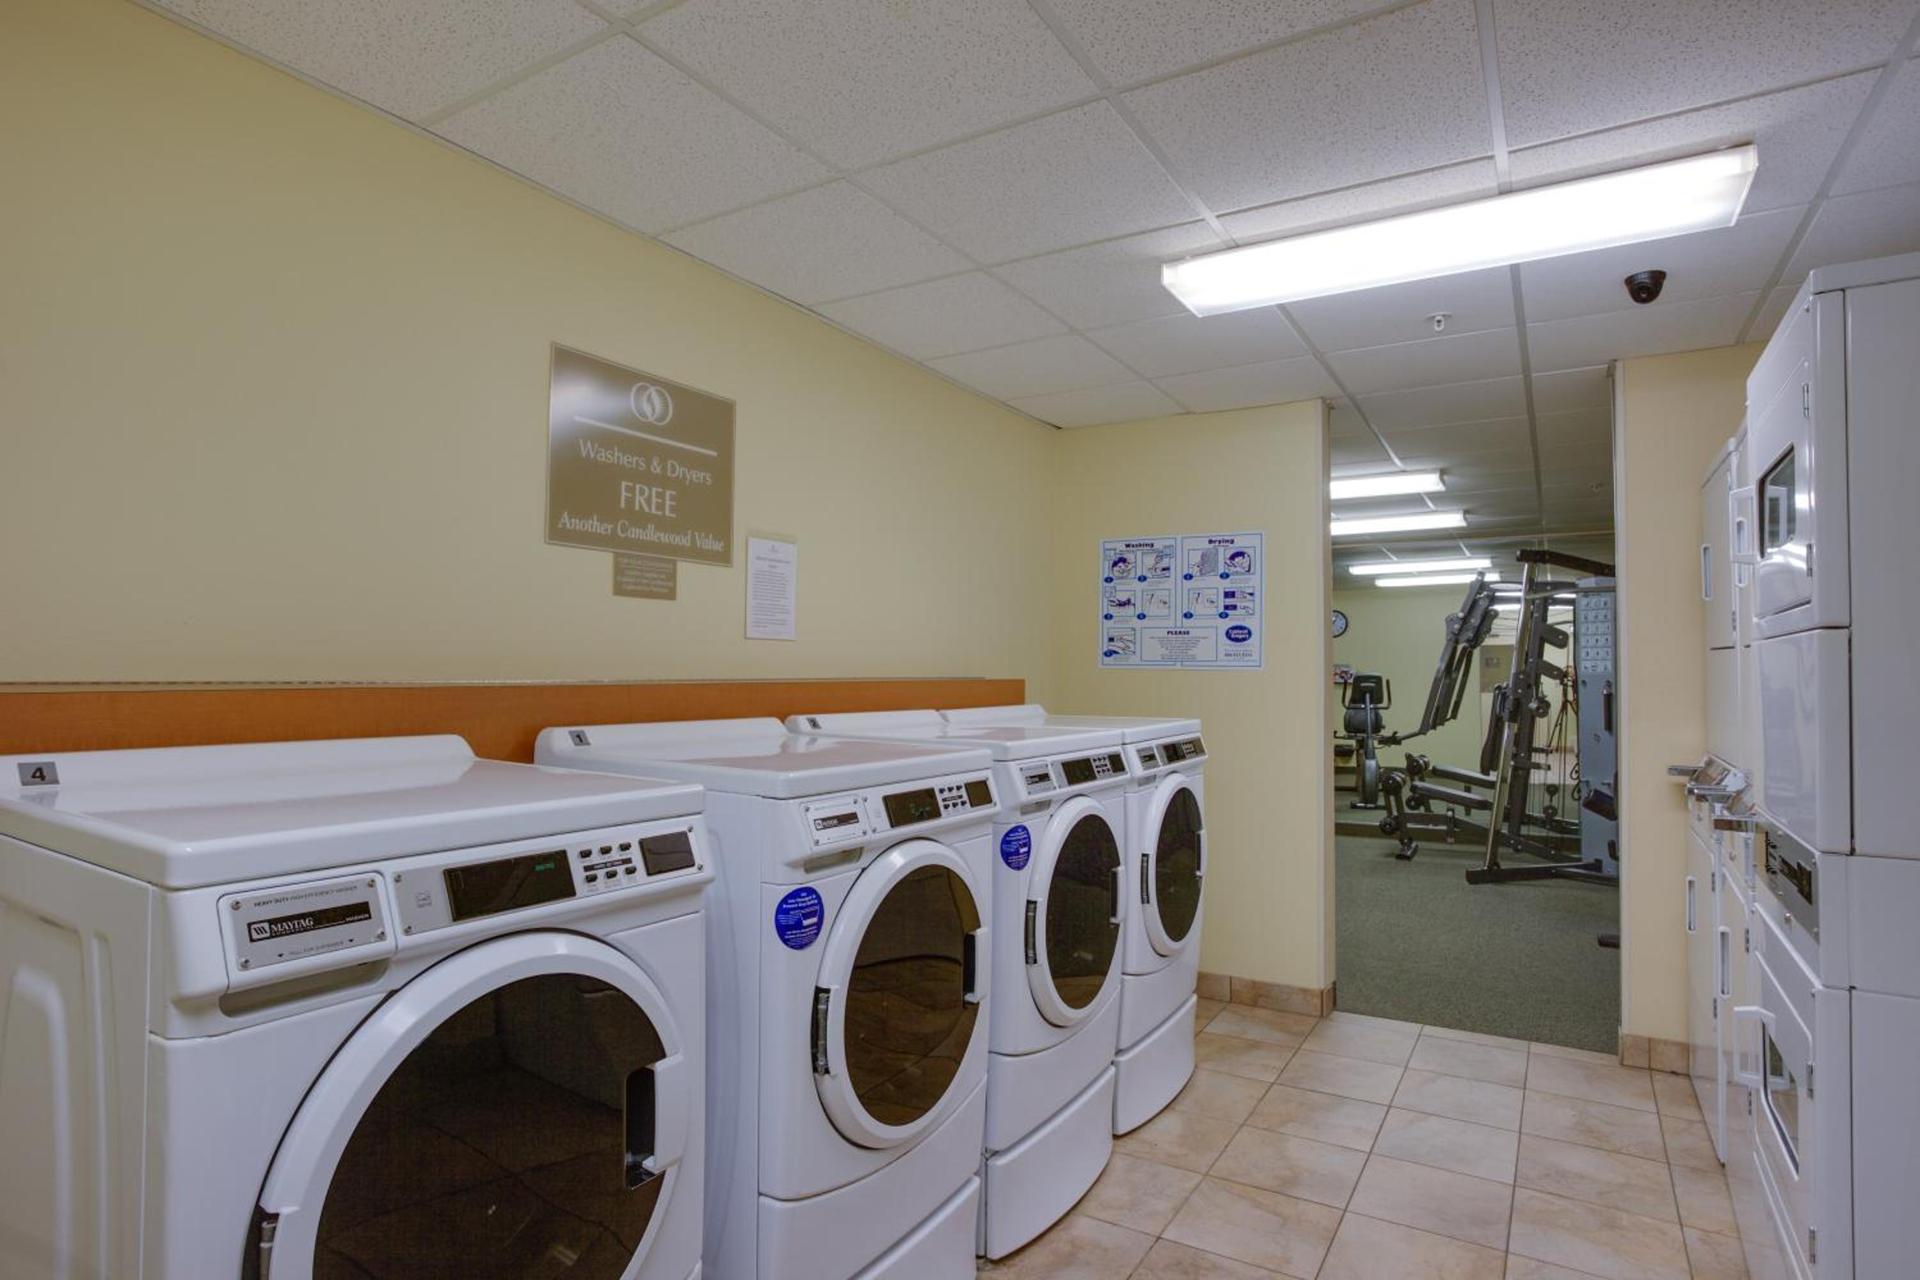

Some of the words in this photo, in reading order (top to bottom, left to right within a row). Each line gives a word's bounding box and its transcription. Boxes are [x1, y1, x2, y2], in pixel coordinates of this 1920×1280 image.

[578, 437, 646, 471] Washers
[650, 455, 664, 475] &
[667, 460, 713, 485] Dryers
[619, 480, 677, 518] FREE
[557, 511, 614, 536] Another
[616, 519, 692, 547] Candlewood
[694, 530, 725, 552] Value
[575, 733, 584, 743] 1
[31, 767, 46, 782] 4
[271, 917, 314, 932] MAYTAG
